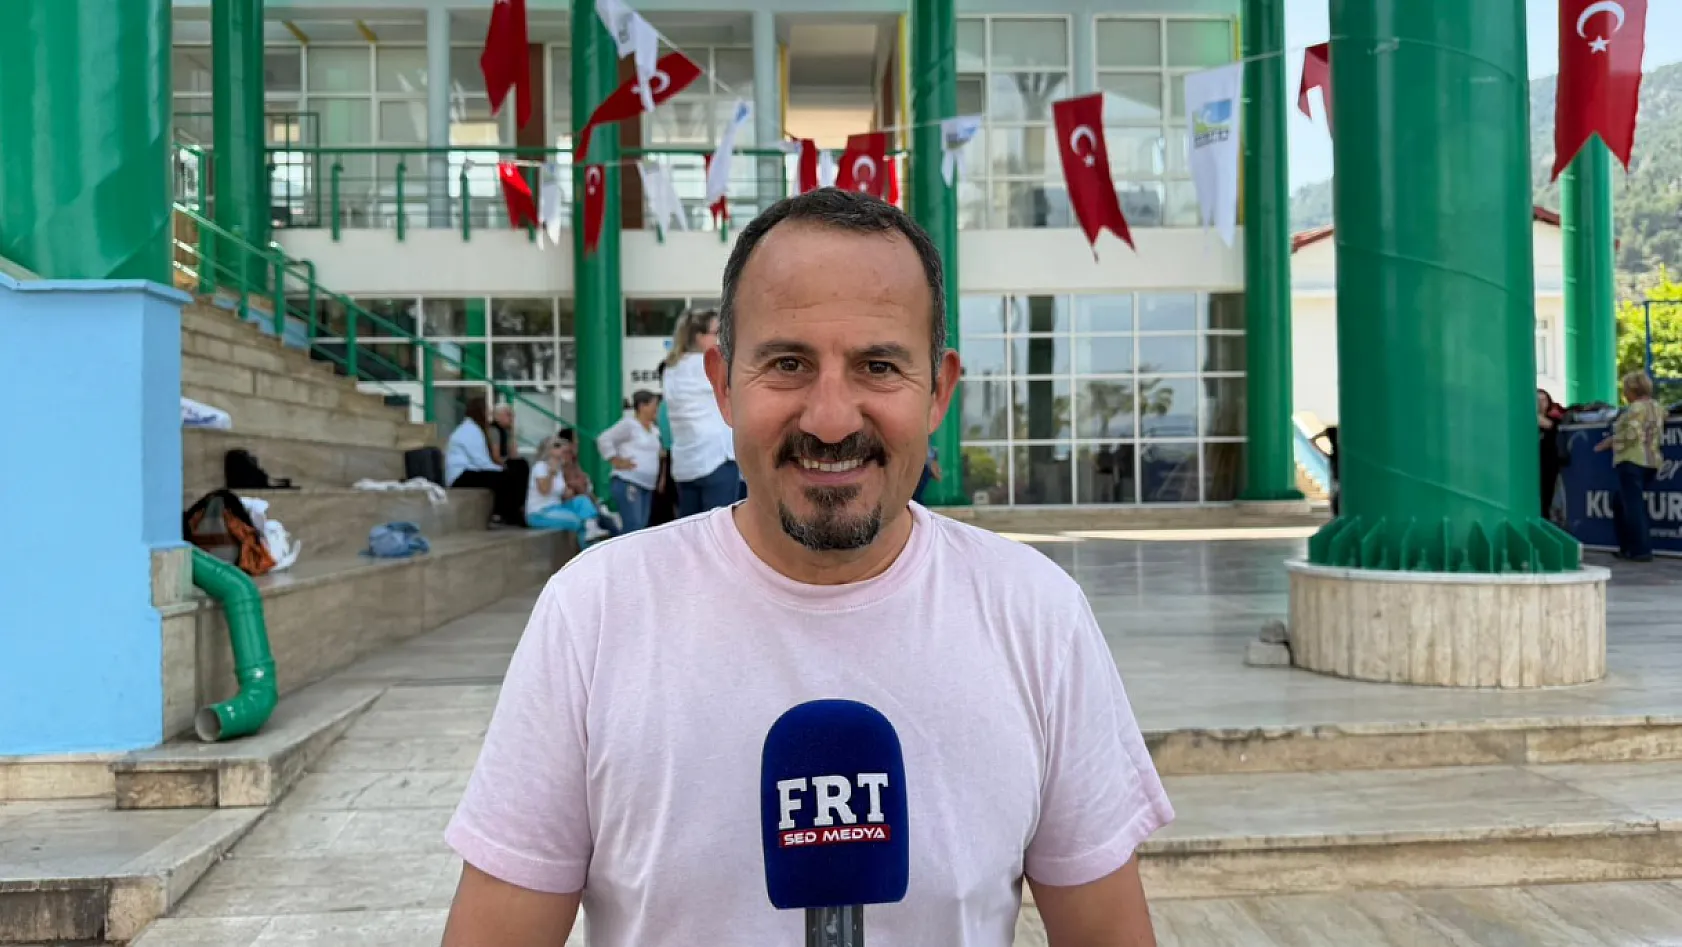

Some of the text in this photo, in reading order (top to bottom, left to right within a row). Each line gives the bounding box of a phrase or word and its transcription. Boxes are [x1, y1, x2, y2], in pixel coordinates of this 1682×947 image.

[777, 773, 889, 830] FRT
[784, 827, 886, 846] SED MEDYA
